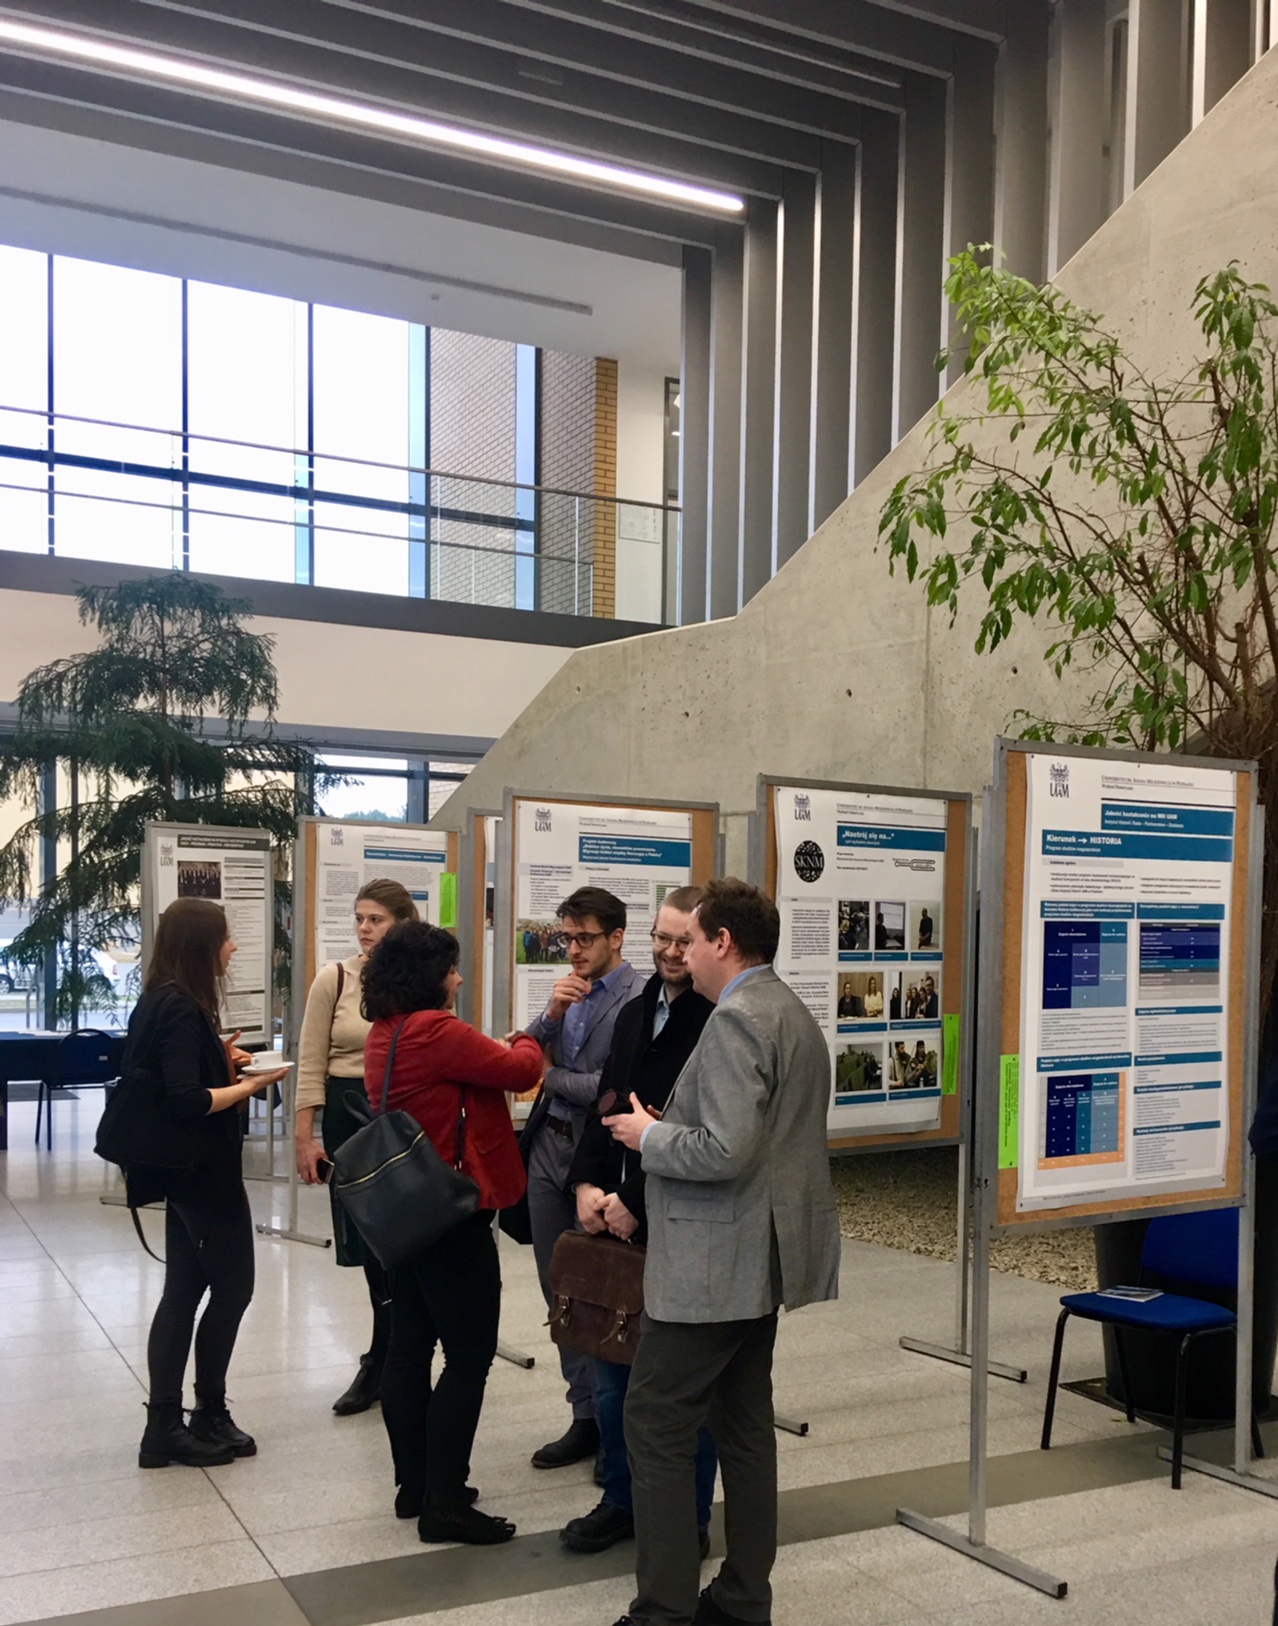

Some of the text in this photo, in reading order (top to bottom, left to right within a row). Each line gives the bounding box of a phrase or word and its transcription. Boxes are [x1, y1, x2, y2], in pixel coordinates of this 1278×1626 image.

[1049, 783, 1070, 798] UAM
[794, 810, 811, 821] UAM
[534, 821, 552, 832] UAM
[868, 832, 878, 840] się
[1046, 834, 1122, 845] Kierunek HISTORIA
[795, 855, 824, 869] SKNM
